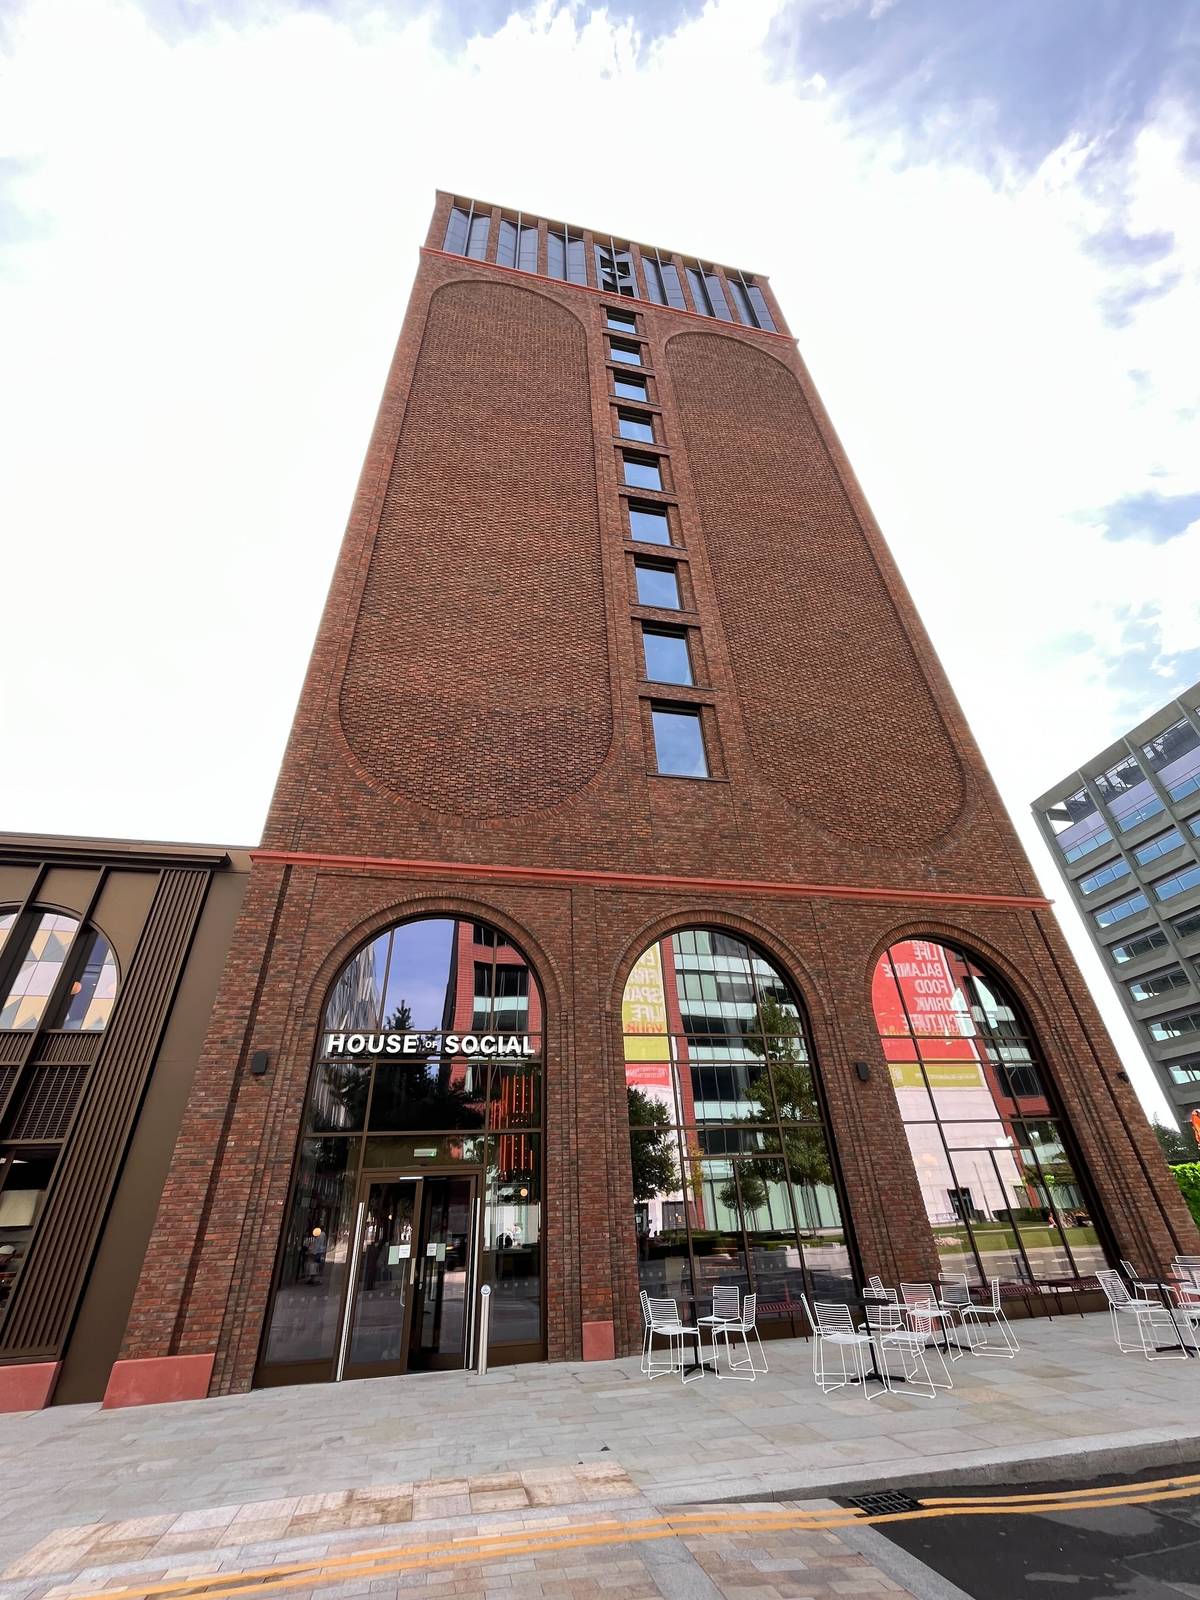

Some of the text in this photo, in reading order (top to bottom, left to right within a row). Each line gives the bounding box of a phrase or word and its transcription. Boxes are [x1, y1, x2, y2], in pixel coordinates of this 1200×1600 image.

[327, 1033, 536, 1054] HOUSE OF SOCIAL
